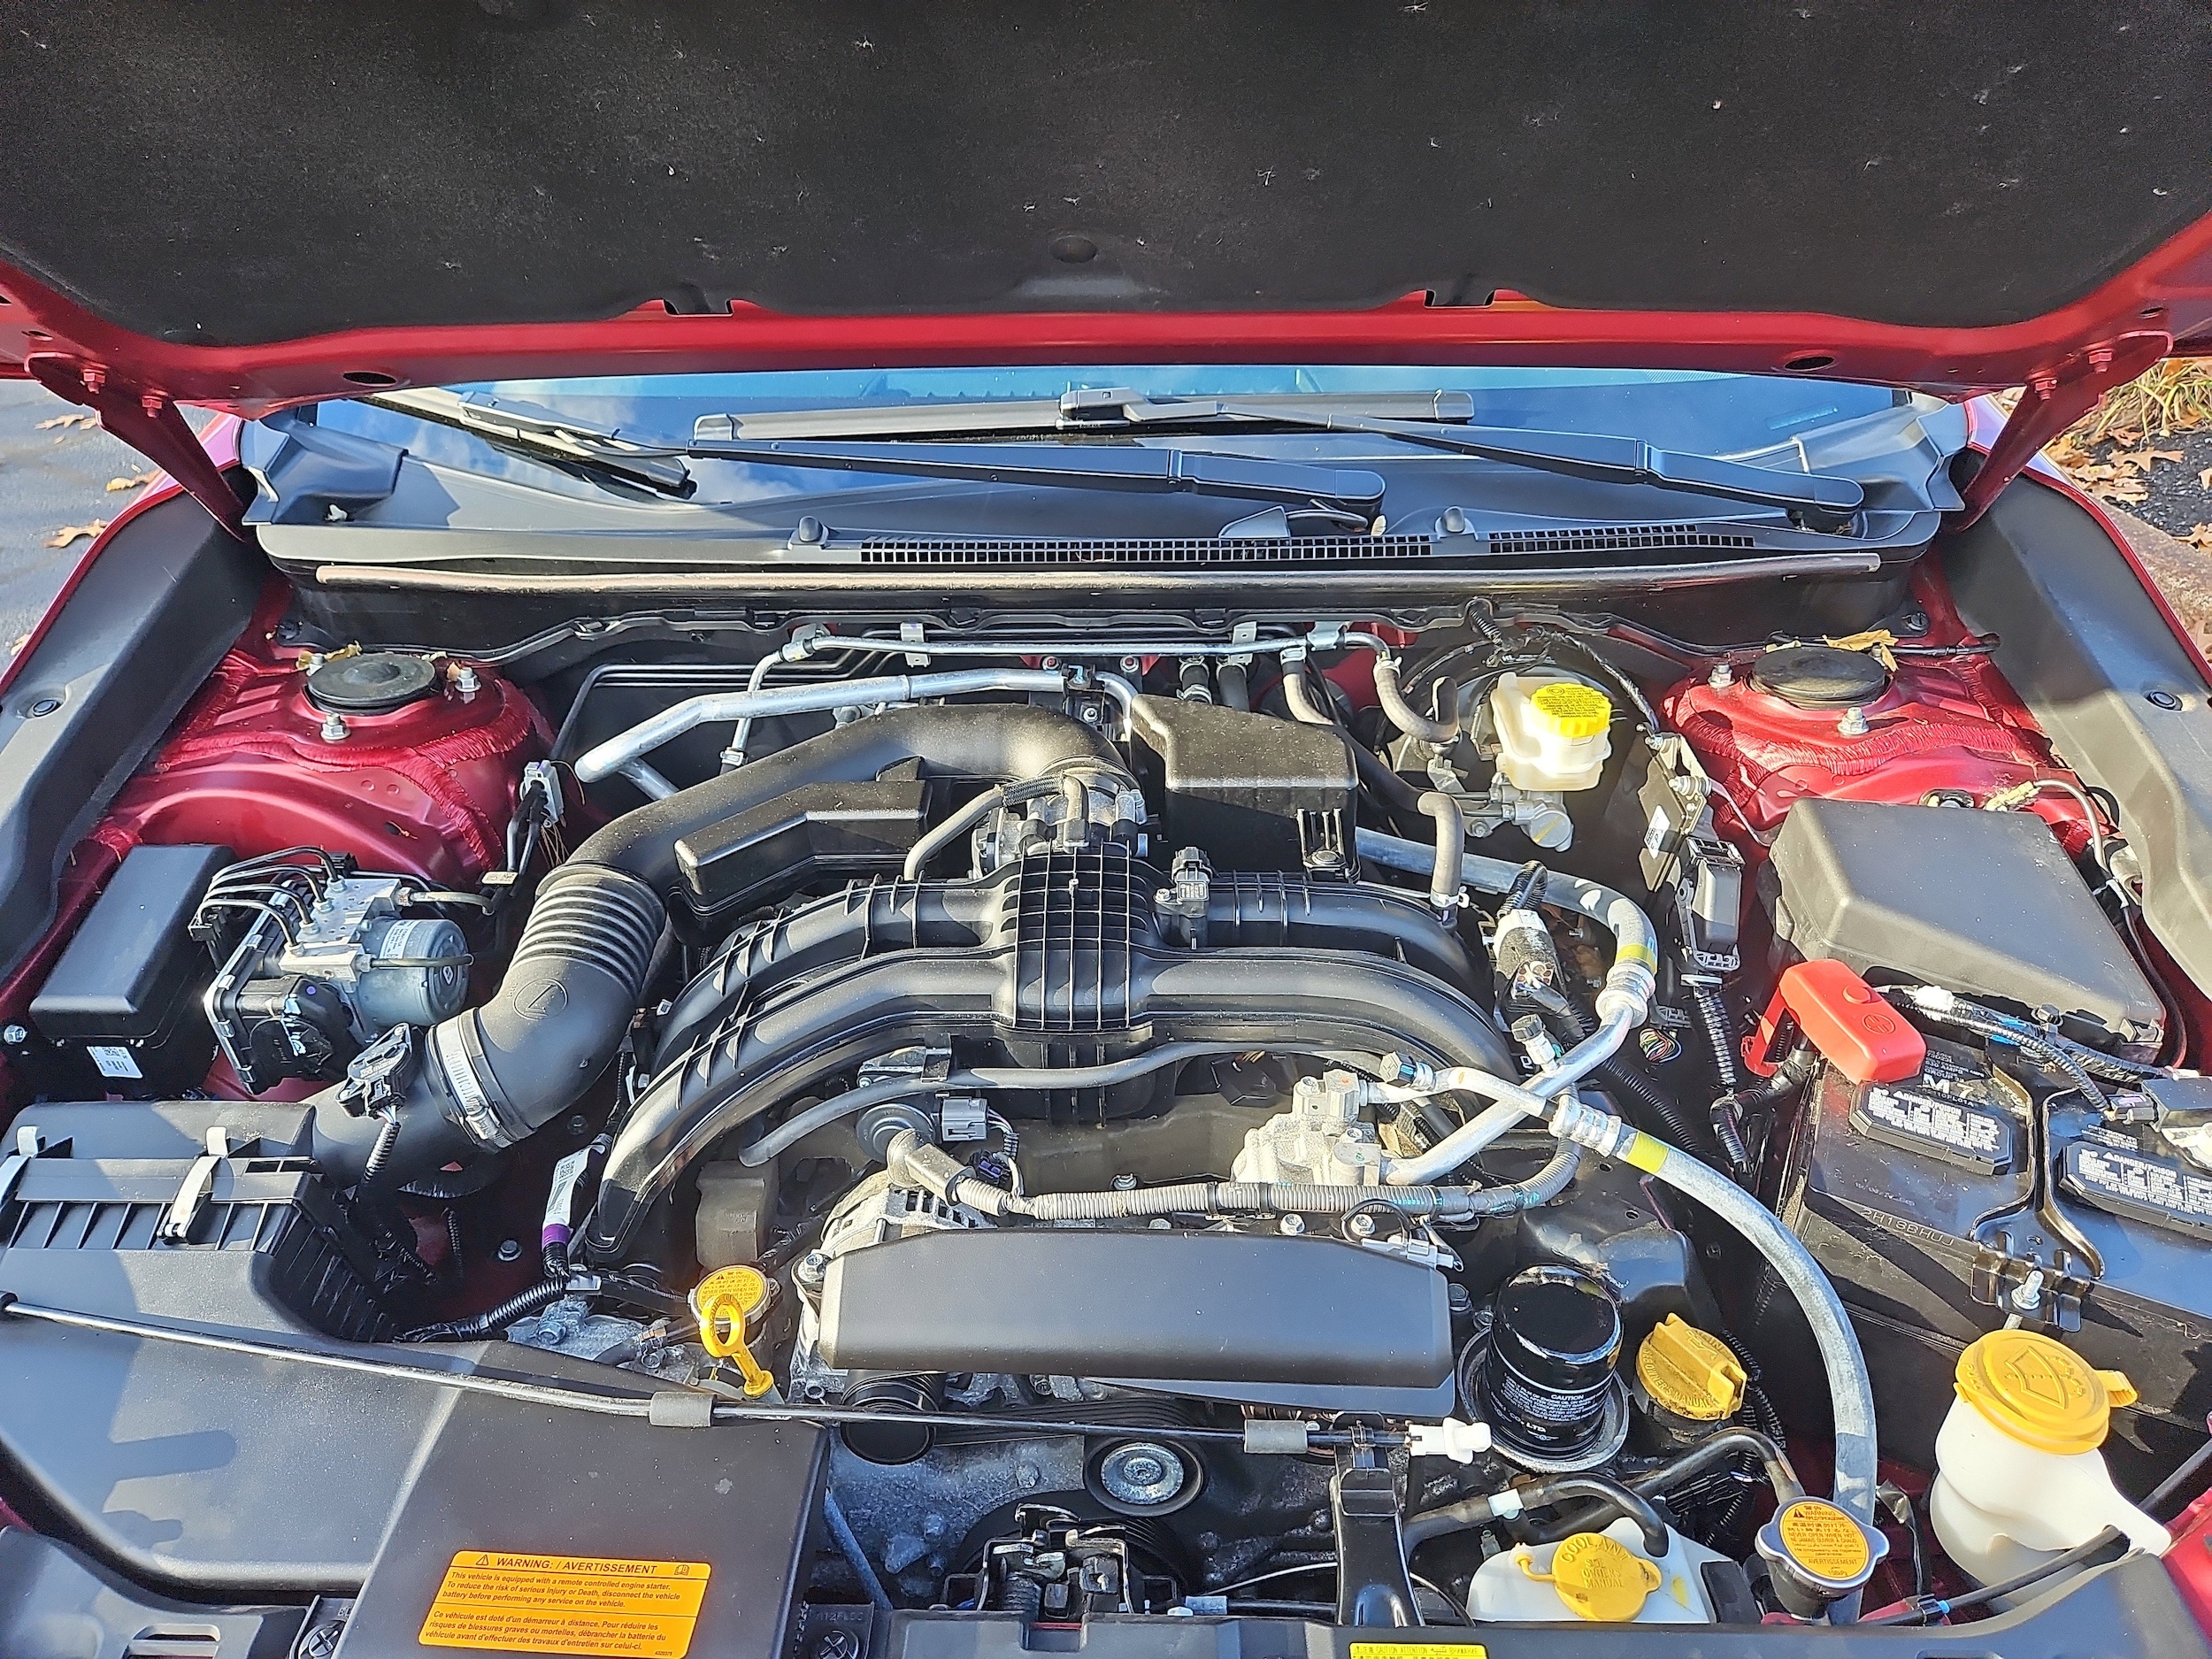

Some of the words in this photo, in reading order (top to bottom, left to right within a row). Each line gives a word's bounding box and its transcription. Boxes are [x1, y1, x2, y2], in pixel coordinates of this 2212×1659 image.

[2113, 1154, 2177, 1179] DANGER/POISON
[1646, 1364, 1673, 1394] OWNER'S
[1674, 1390, 1711, 1409] MANUAL
[1560, 1535, 1632, 1563] COOLANT
[497, 1557, 553, 1569] WARNING:
[556, 1561, 562, 1570] /
[563, 1561, 657, 1574] AVERTISSEMENT
[502, 1575, 534, 1584] equipped
[1584, 1578, 1624, 1589] MANUAL
[442, 1590, 466, 1600] battery
[469, 1591, 492, 1600] before
[492, 1594, 532, 1603] performing
[457, 1581, 481, 1590] reduce
[495, 1583, 509, 1592] risk
[578, 1588, 600, 1597] Death,
[445, 1611, 474, 1620] véhicule
[488, 1613, 504, 1622] doté
[505, 1615, 521, 1624] d'un
[523, 1617, 560, 1626] démarreur
[567, 1619, 600, 1628] distance.
[602, 1620, 620, 1629] Pour
[620, 1621, 646, 1630] réduire
[426, 1630, 456, 1639] véhicule
[478, 1633, 517, 1643] d'effectuer
[517, 1635, 531, 1644] des
[532, 1637, 559, 1646] travaux
[560, 1638, 599, 1647] d'entretien
[429, 1621, 456, 1630] risques
[468, 1623, 503, 1632] blessures
[503, 1625, 529, 1634] graves
[541, 1628, 577, 1638] mortelles,
[578, 1629, 618, 1639] débrancher
[627, 1632, 655, 1640] batterie
